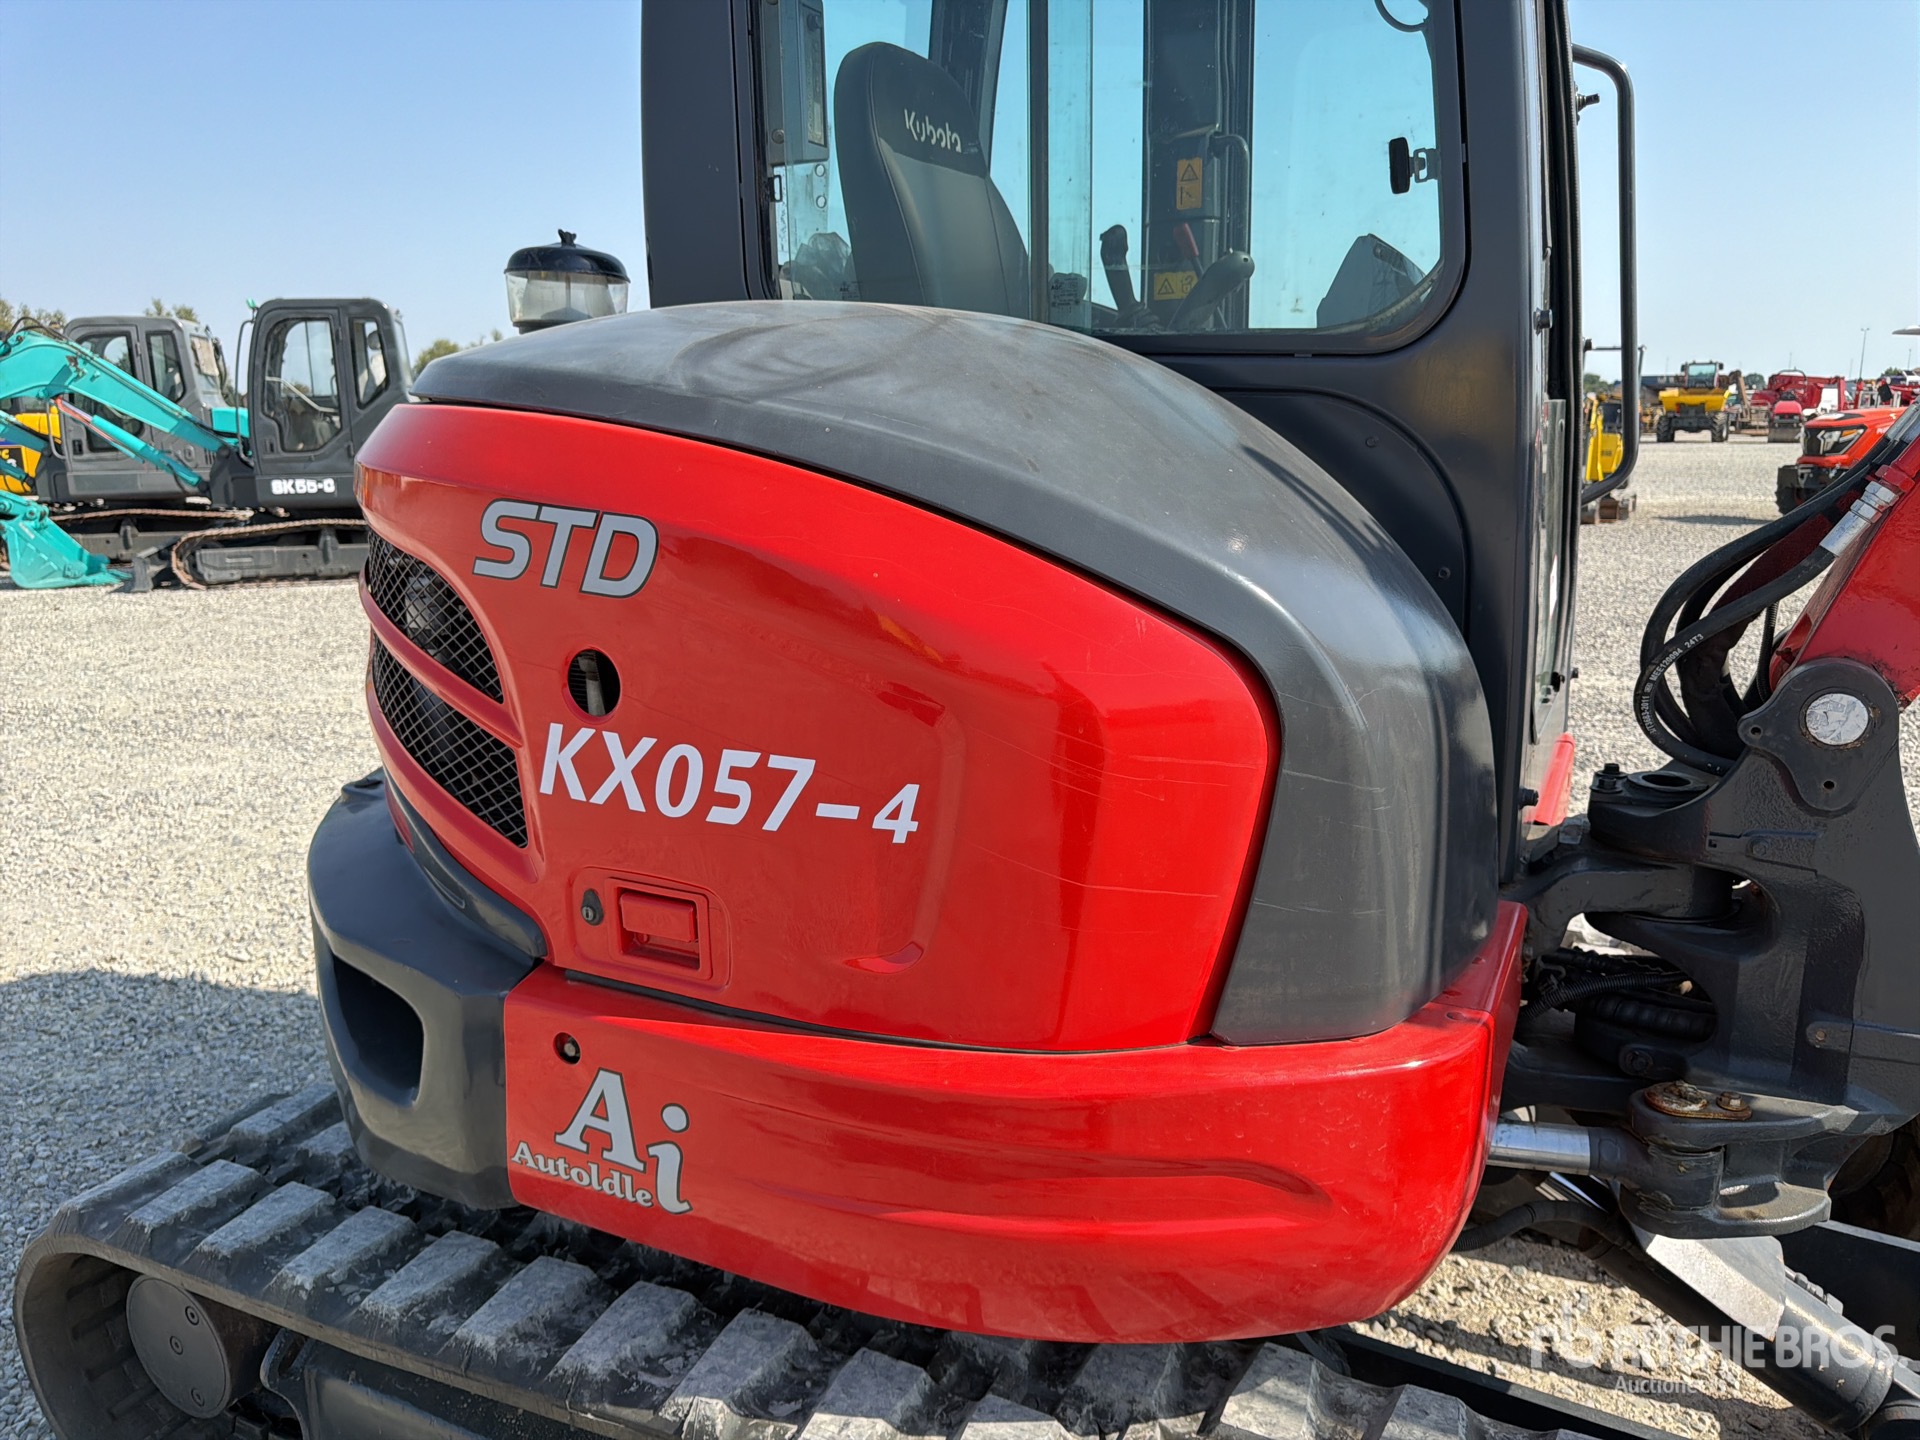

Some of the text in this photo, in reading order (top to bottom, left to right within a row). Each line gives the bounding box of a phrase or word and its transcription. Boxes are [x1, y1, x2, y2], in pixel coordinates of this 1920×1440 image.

[904, 108, 962, 153] Kubota
[473, 498, 660, 599] STD
[1684, 633, 1704, 649] 24T3
[539, 722, 920, 844] KX057-4
[554, 1066, 693, 1215] Ai
